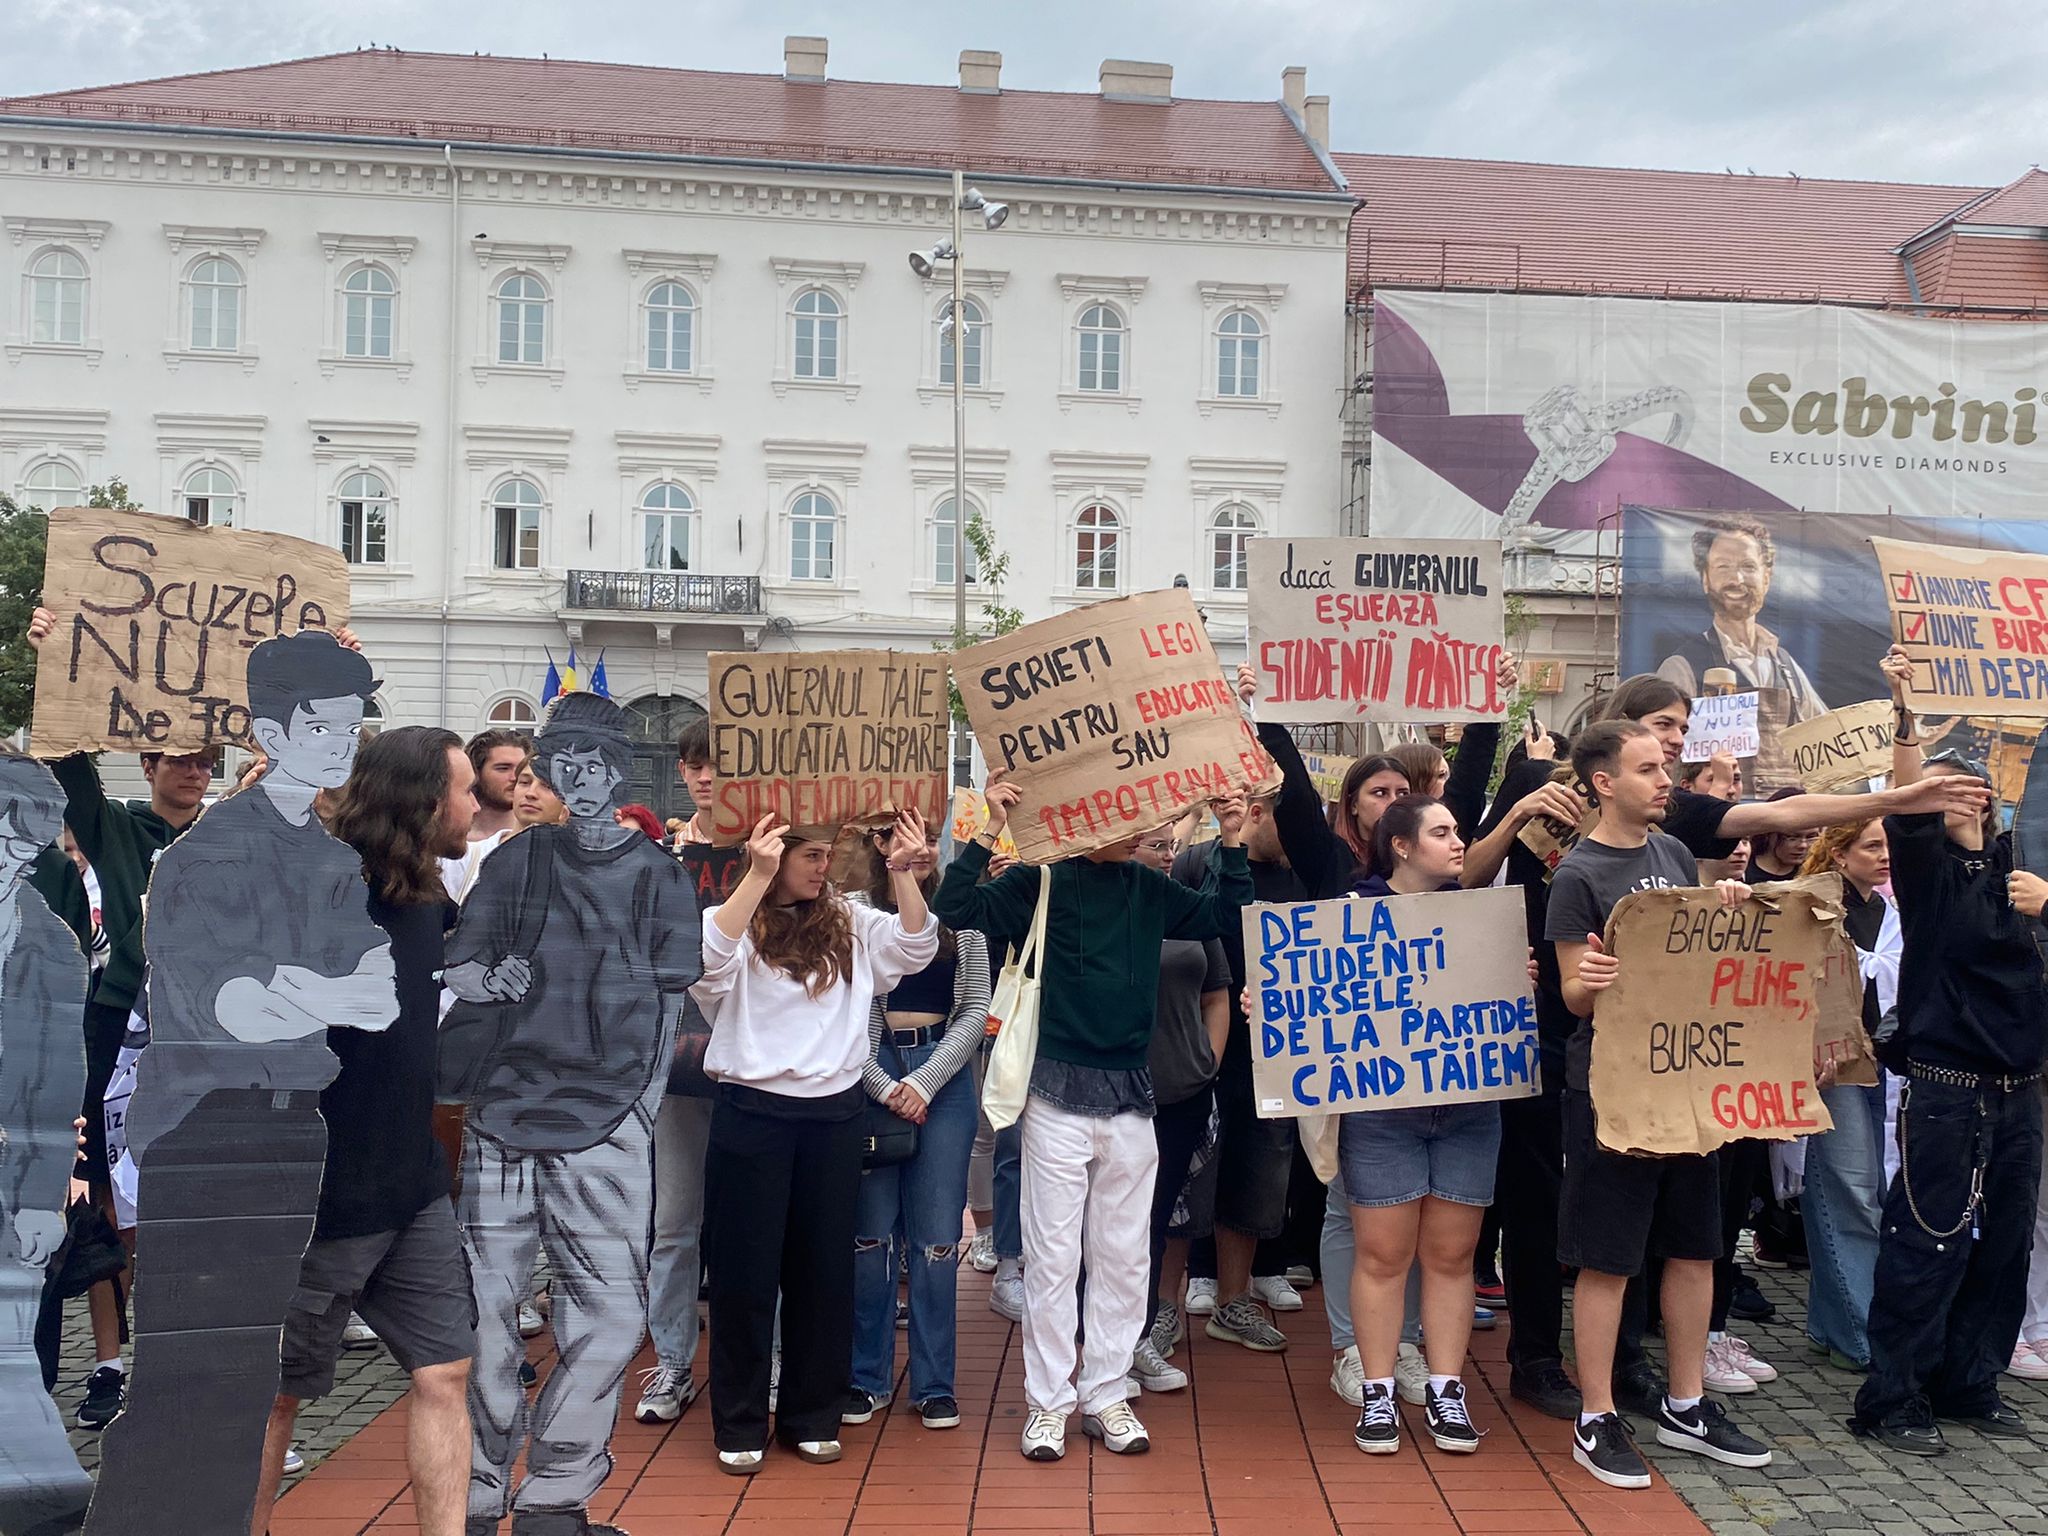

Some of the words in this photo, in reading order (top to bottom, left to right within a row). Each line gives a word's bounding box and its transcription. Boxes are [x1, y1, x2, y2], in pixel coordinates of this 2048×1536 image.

[1740, 372, 2038, 446] Sabrini
[1769, 451, 1884, 469] EXCLUSIVE
[1895, 456, 2008, 474] DIAMONDS
[1354, 553, 1488, 597] GUVERNUL
[69, 612, 209, 697] NU
[1139, 622, 1202, 659] LEGI
[719, 664, 868, 719] GUVERNUL
[999, 702, 1120, 772] PENTRU
[1260, 904, 1321, 953] DE
[1342, 900, 1397, 944] LA
[1665, 907, 1782, 954] BAGAJE
[1262, 1020, 1310, 1058] DE
[1322, 1013, 1380, 1055] LA
[1650, 1022, 1745, 1075] BURSE
[1291, 1055, 1406, 1107] CÂND
[1710, 1081, 1819, 1130] GOALE
